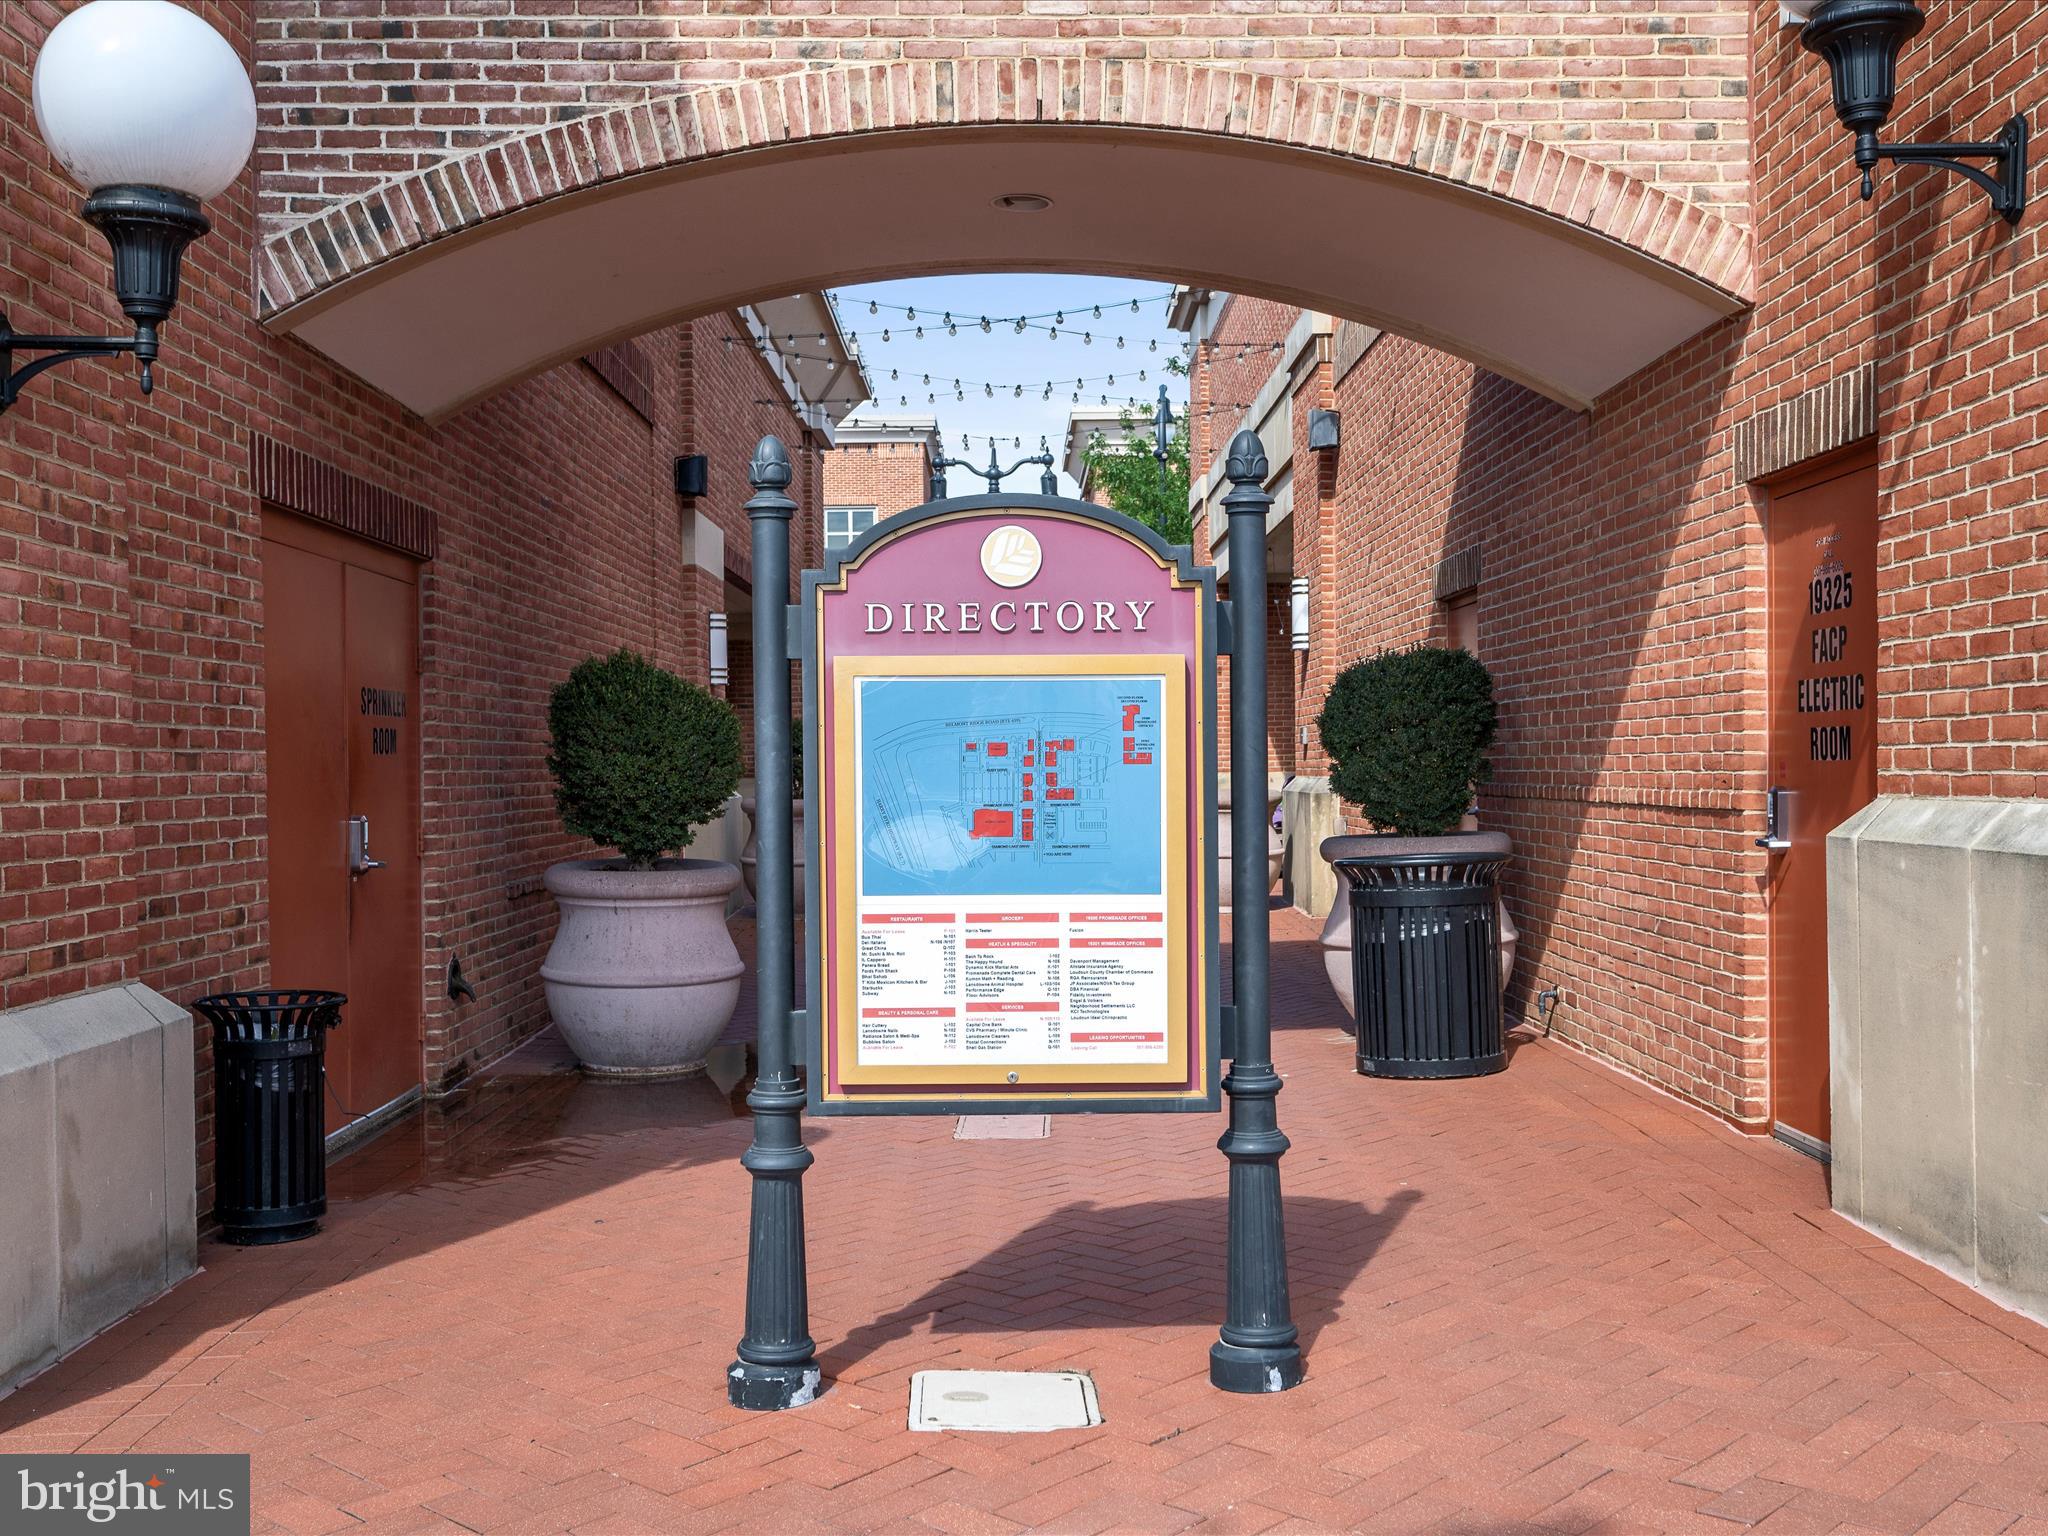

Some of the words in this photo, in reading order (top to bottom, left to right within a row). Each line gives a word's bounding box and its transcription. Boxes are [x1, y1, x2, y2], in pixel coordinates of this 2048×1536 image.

[1808, 572, 1853, 615] 19325
[864, 601, 1154, 633] DIRECTORY
[1812, 625, 1848, 664] FACP
[360, 686, 407, 718] SPRINKLER
[1798, 674, 1865, 713] ELECTRIC
[372, 728, 397, 755] ROOM
[1810, 726, 1851, 761] ROOM
